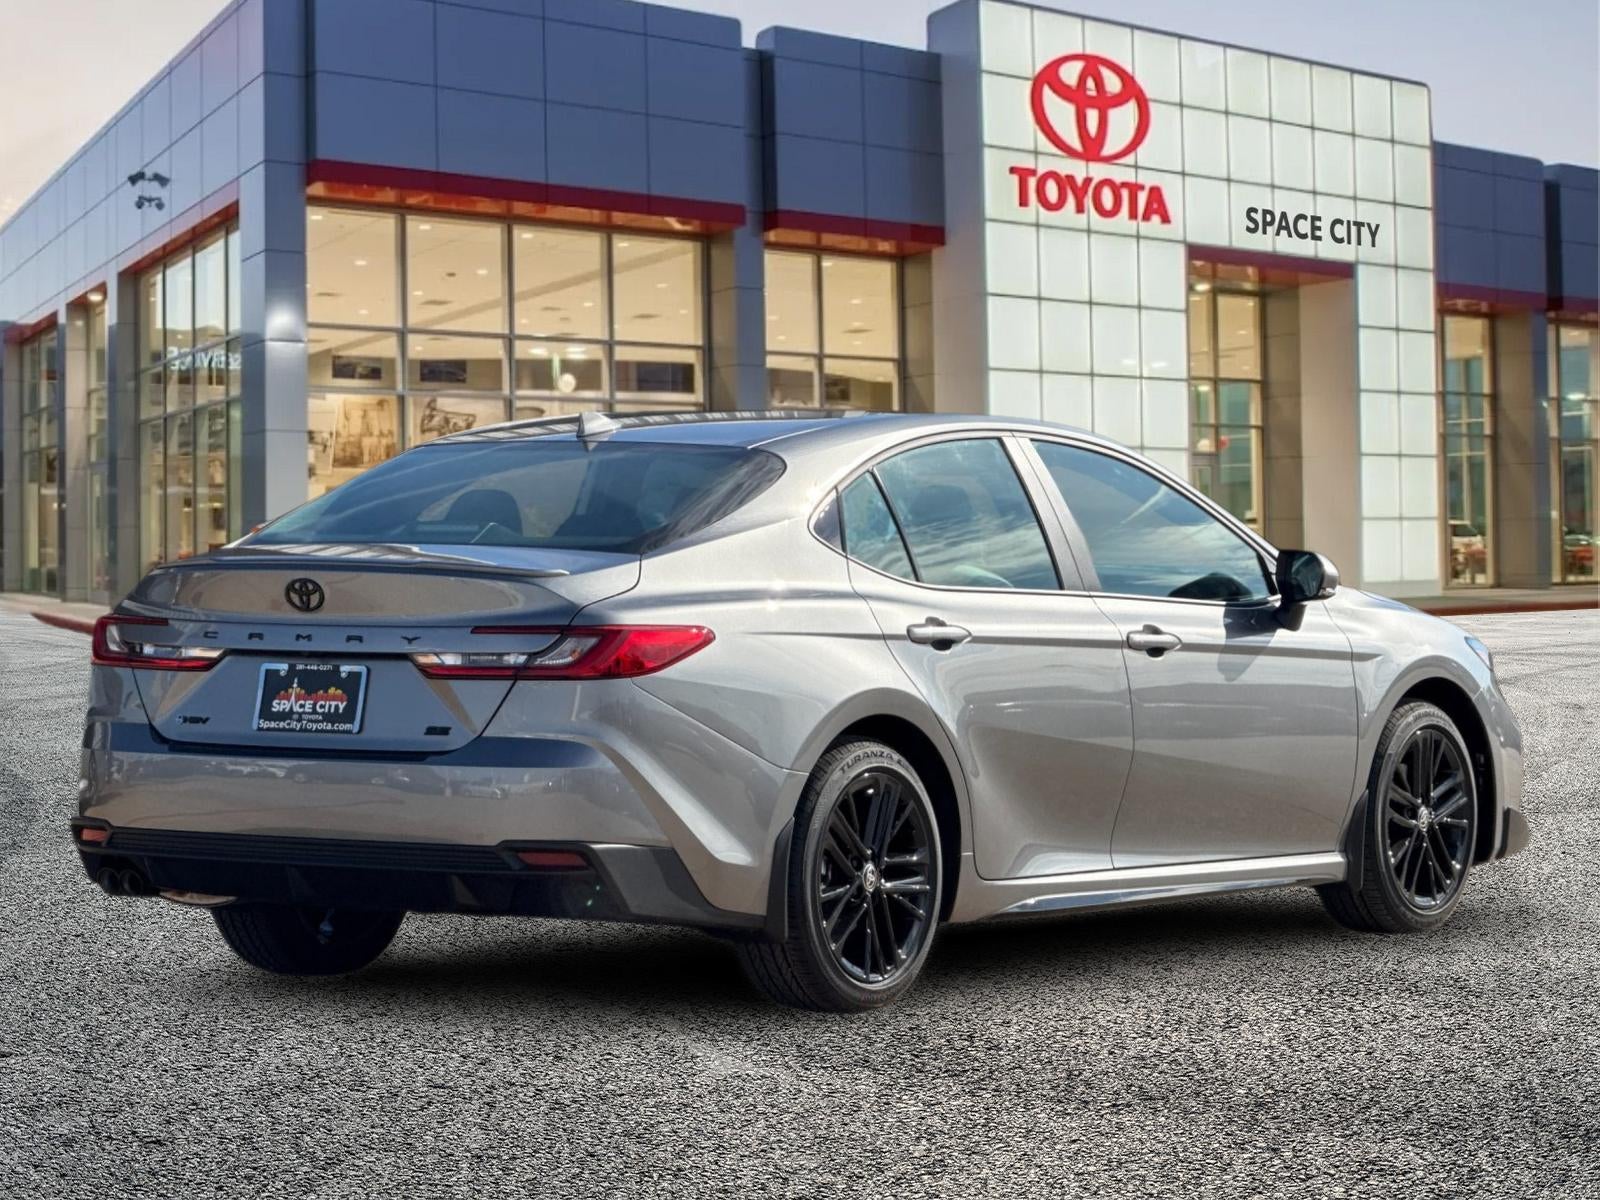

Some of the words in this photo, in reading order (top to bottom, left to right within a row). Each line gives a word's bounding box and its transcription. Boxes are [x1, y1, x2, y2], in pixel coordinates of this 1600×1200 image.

[1009, 166, 1171, 225] TOYOTA
[1245, 206, 1322, 242] SPACE
[1329, 218, 1381, 248] CITY
[203, 631, 421, 645] CAMRY
[271, 700, 313, 712] SPACE
[316, 701, 347, 713] CITY
[259, 719, 353, 731] SpaceCityToyota.com
[840, 750, 894, 774] TURANZA
